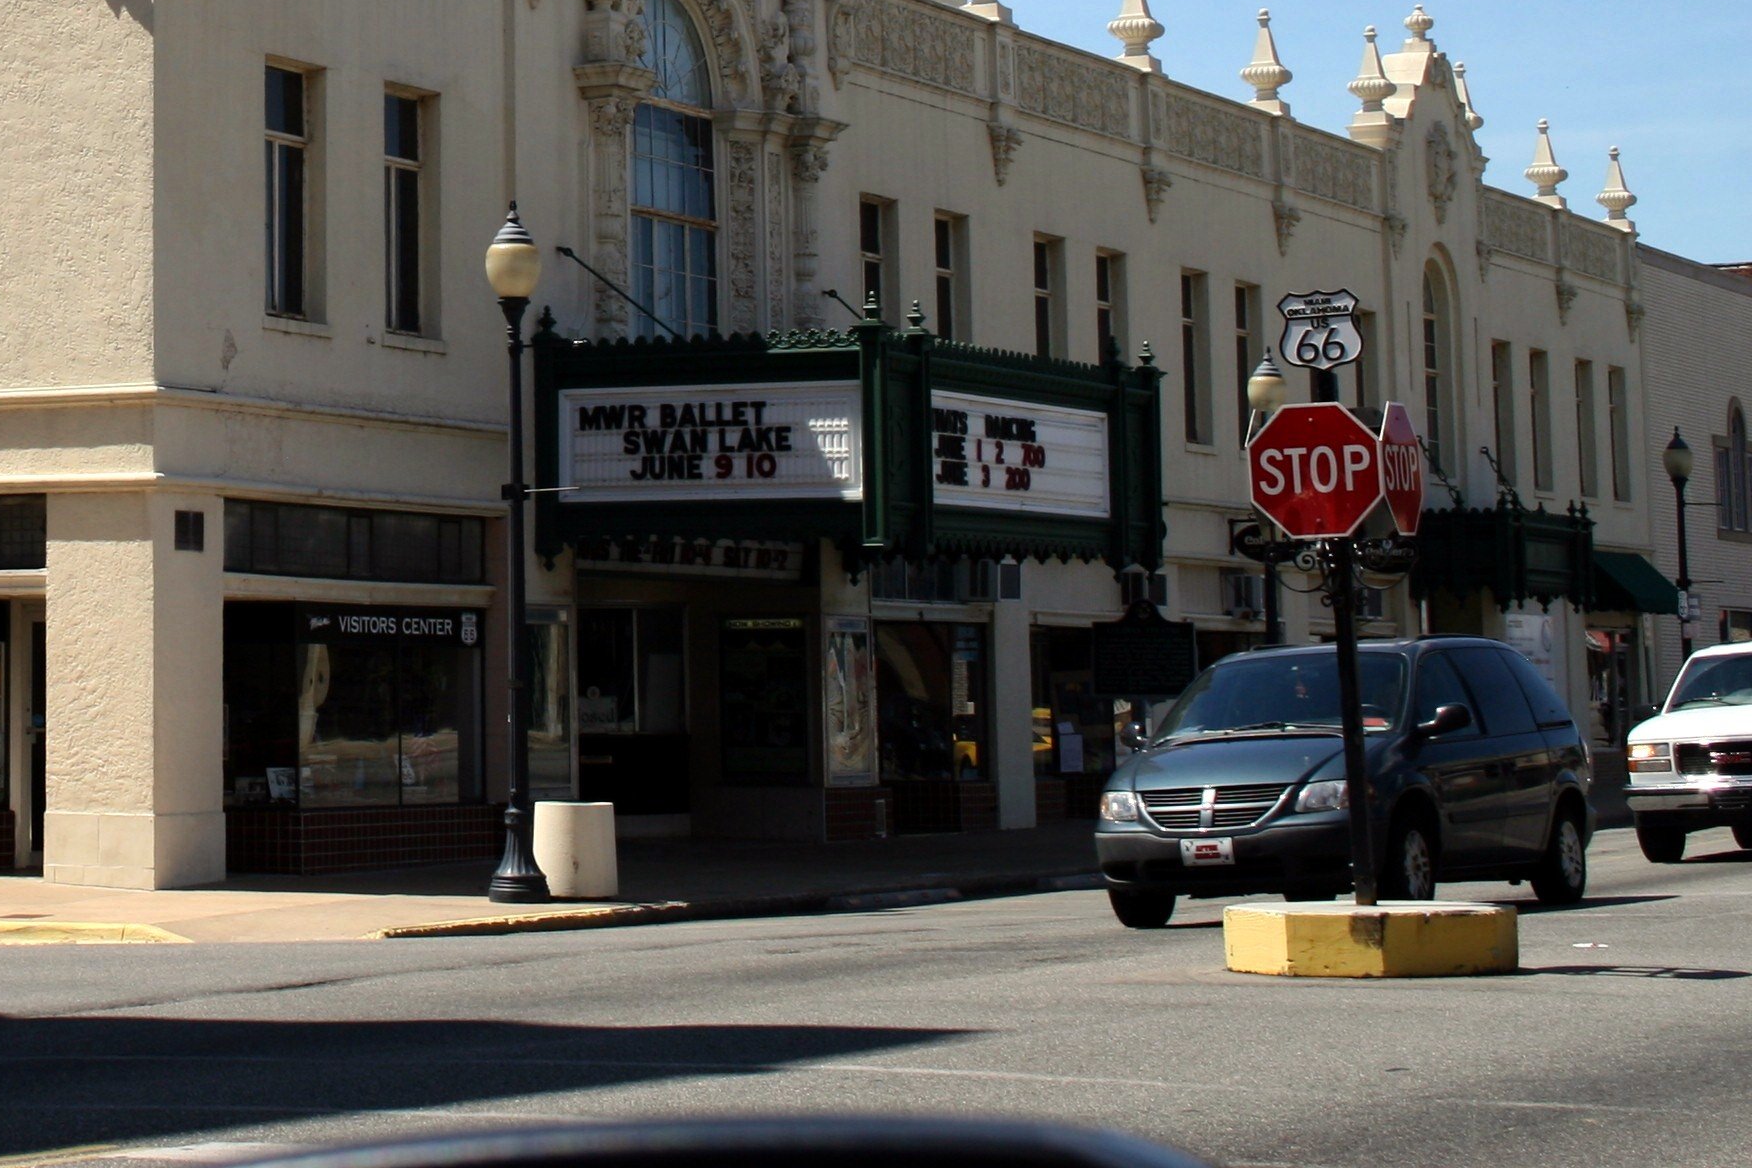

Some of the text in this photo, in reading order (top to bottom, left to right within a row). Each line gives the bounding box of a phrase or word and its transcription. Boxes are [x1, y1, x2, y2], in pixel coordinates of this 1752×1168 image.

[1287, 305, 1349, 317] OKLAHOMA
[1311, 317, 1329, 329] US
[1296, 327, 1346, 363] 66
[579, 401, 767, 431] MWR BALLET
[623, 426, 792, 455] SWAN LAKE
[995, 440, 1005, 465] 2
[1021, 442, 1046, 468] 700
[630, 453, 777, 480] JUNE 9 10
[981, 463, 991, 488] 3
[1005, 466, 1031, 491] 200
[1259, 444, 1371, 496] STOP
[1385, 444, 1418, 491] STOP
[338, 615, 397, 633] VISITORS
[402, 617, 453, 635] CENTER
